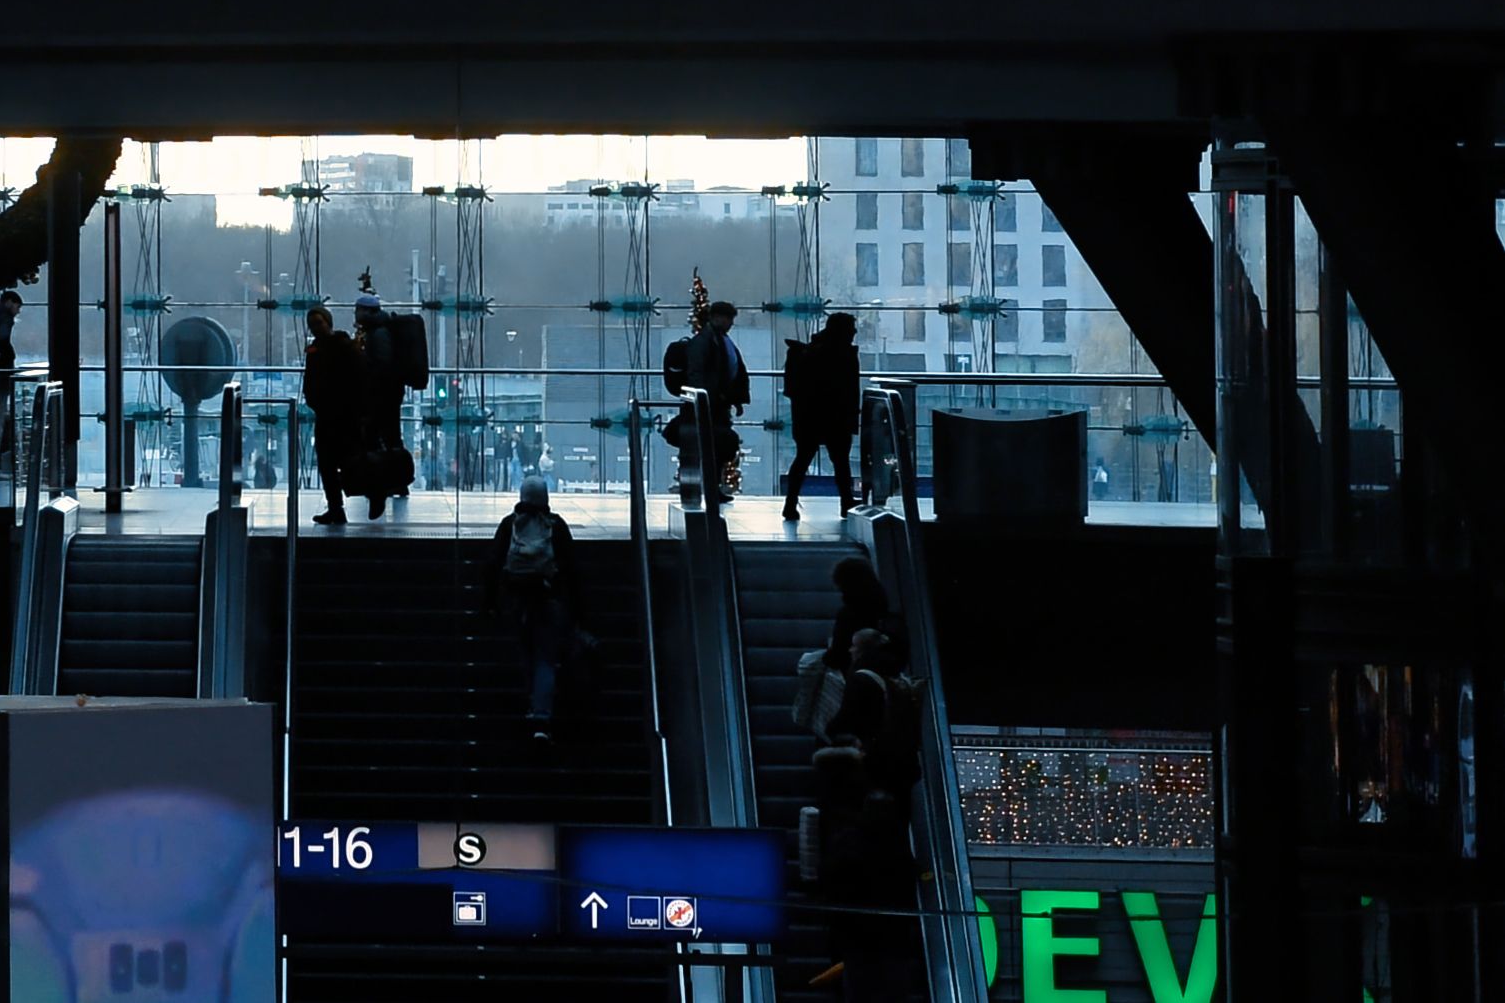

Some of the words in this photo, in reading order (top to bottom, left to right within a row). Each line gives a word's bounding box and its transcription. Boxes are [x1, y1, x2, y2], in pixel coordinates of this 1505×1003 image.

[276, 825, 374, 870] 1-16
[458, 834, 482, 864] S
[629, 916, 659, 927] Lounge
